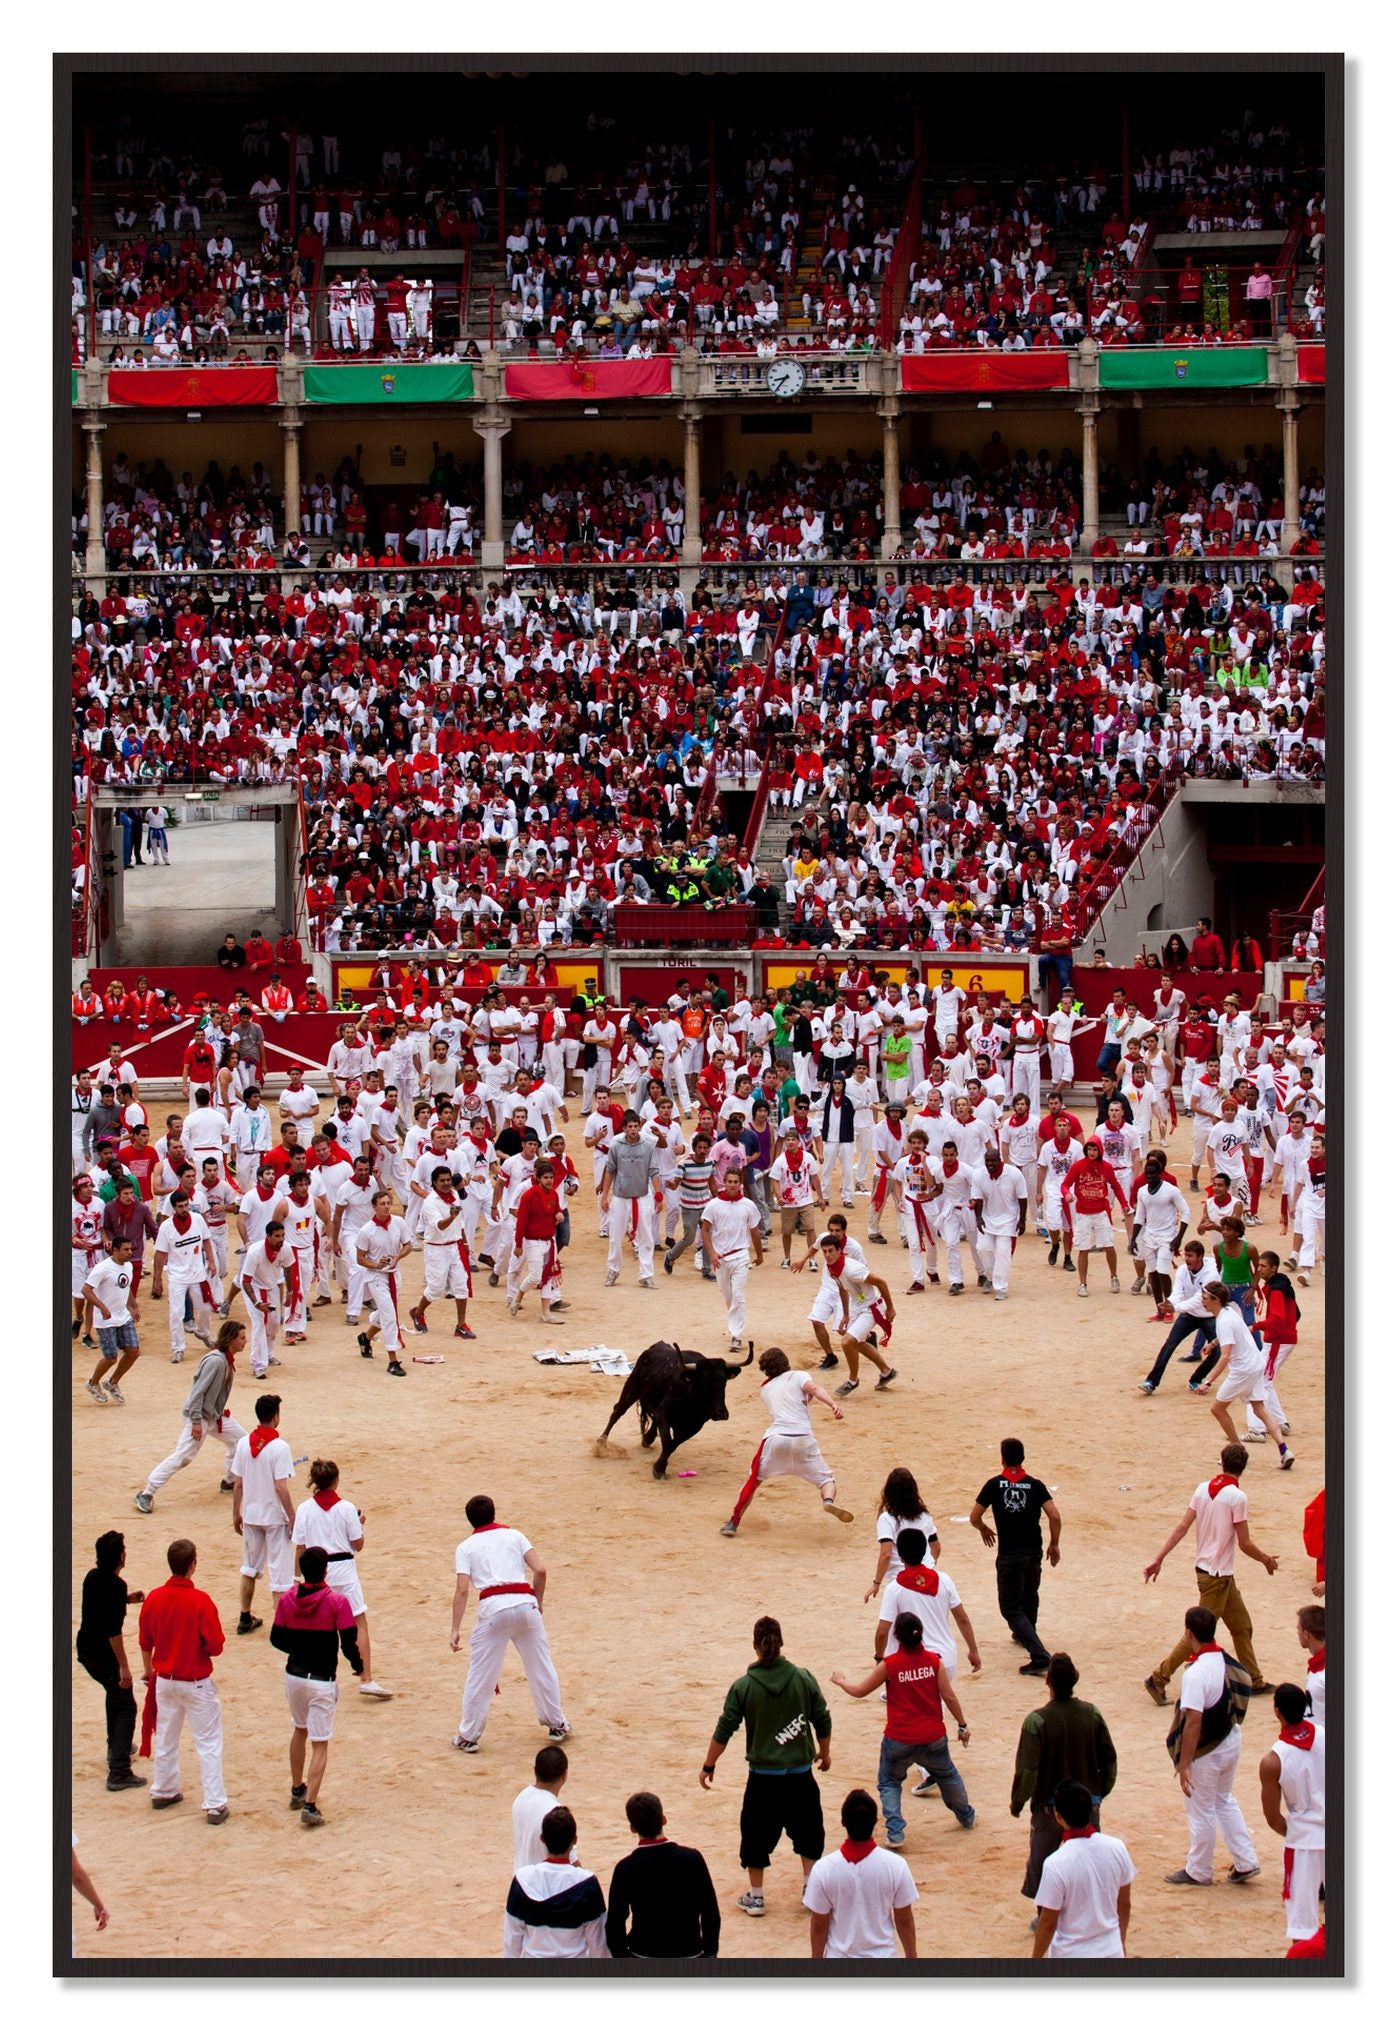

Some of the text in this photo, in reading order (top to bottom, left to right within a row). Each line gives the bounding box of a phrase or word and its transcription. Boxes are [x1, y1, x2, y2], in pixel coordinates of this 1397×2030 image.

[663, 958, 697, 967] TORIL
[969, 975, 983, 991] 6
[898, 1665, 936, 1682] GALLEGA
[775, 1713, 807, 1745] INEFC
